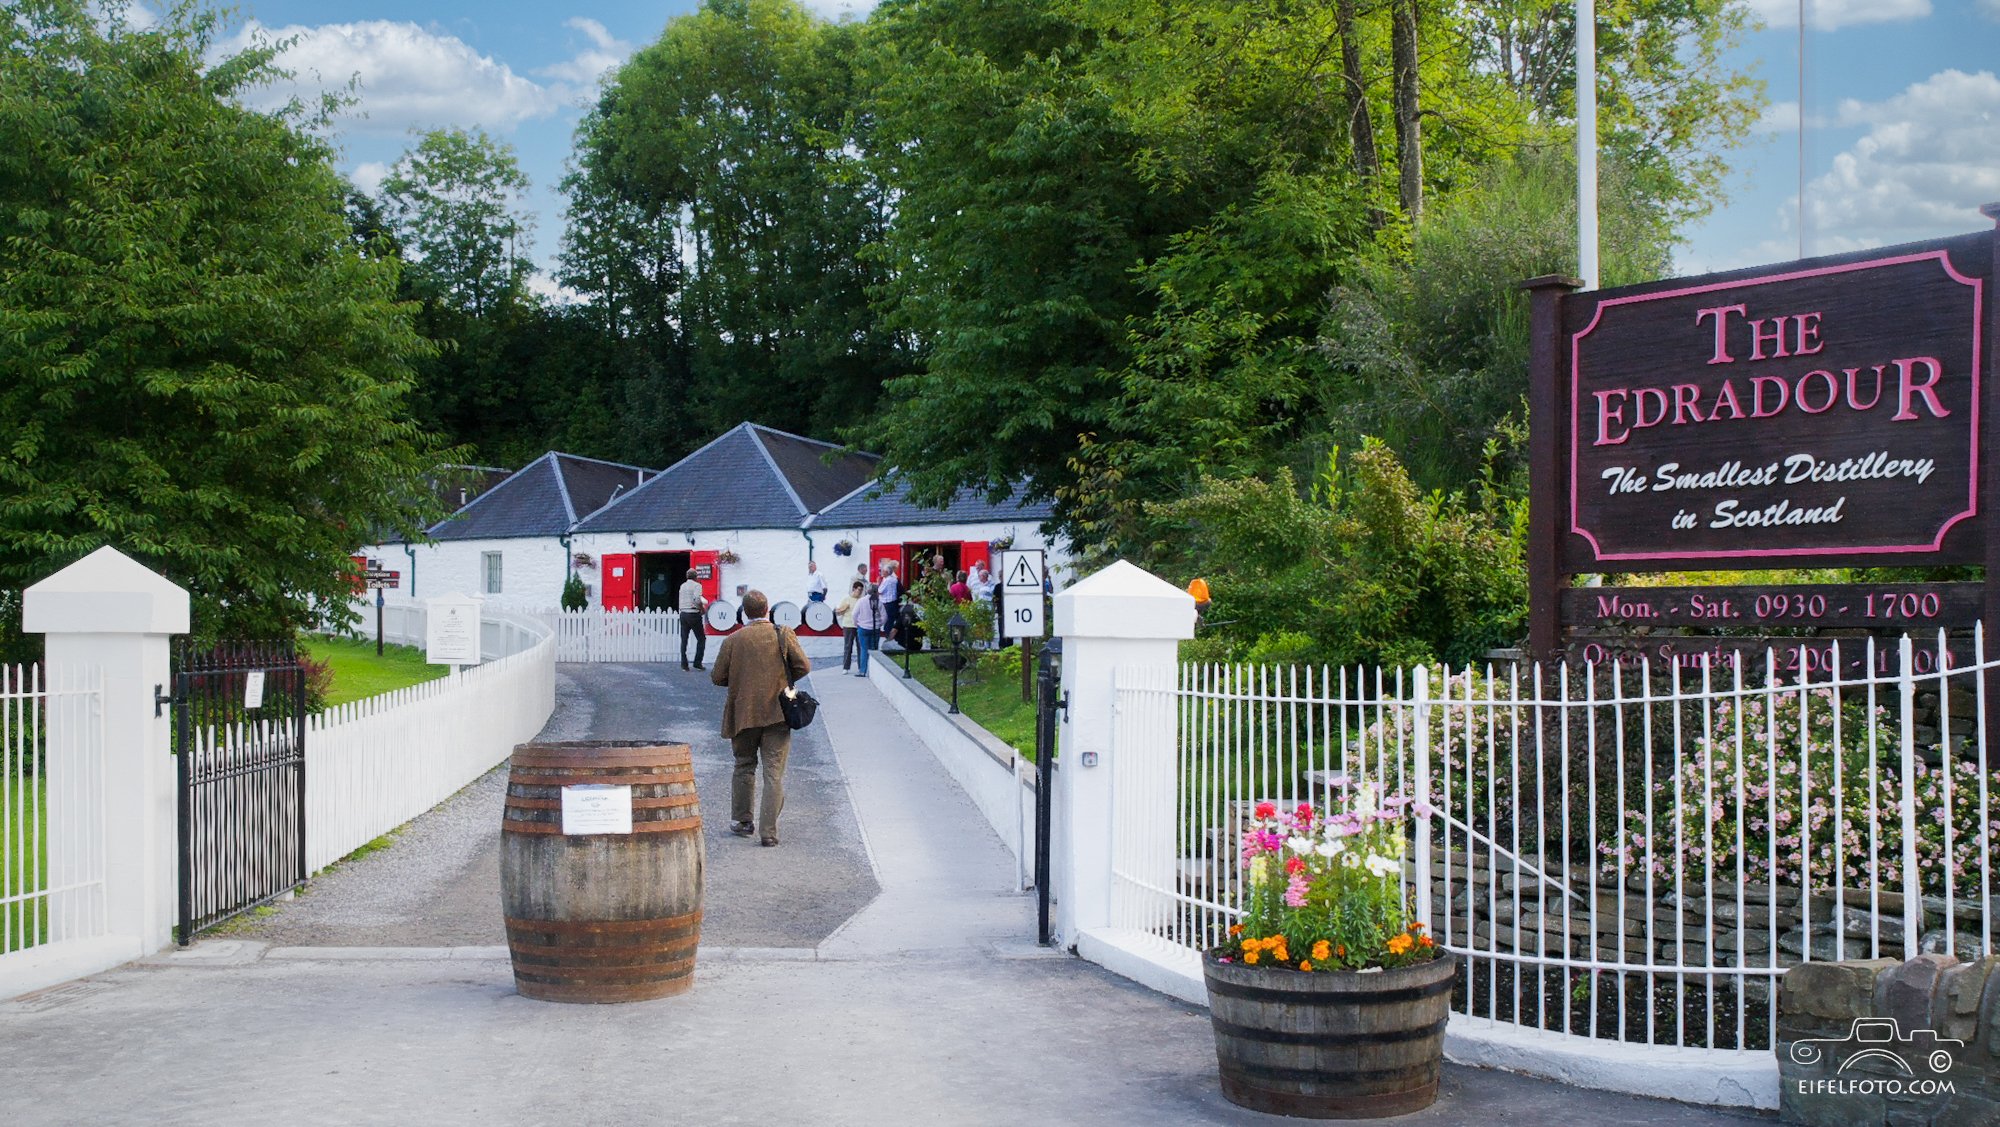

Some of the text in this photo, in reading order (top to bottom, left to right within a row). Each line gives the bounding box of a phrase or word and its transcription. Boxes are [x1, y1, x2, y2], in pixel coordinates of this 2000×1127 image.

[1592, 356, 1951, 447] EDRADOUR
[1601, 450, 1936, 495] The Smallest Distillery
[1671, 496, 1846, 530] in Scotland
[1014, 608, 1033, 623] 10
[1597, 595, 1660, 618] Mon.
[1690, 594, 1740, 618] Sat.
[1755, 593, 1827, 618] 0930
[1864, 592, 1941, 618] 1700
[1659, 644, 1740, 669] Sunda
[1879, 648, 1957, 673] 100
